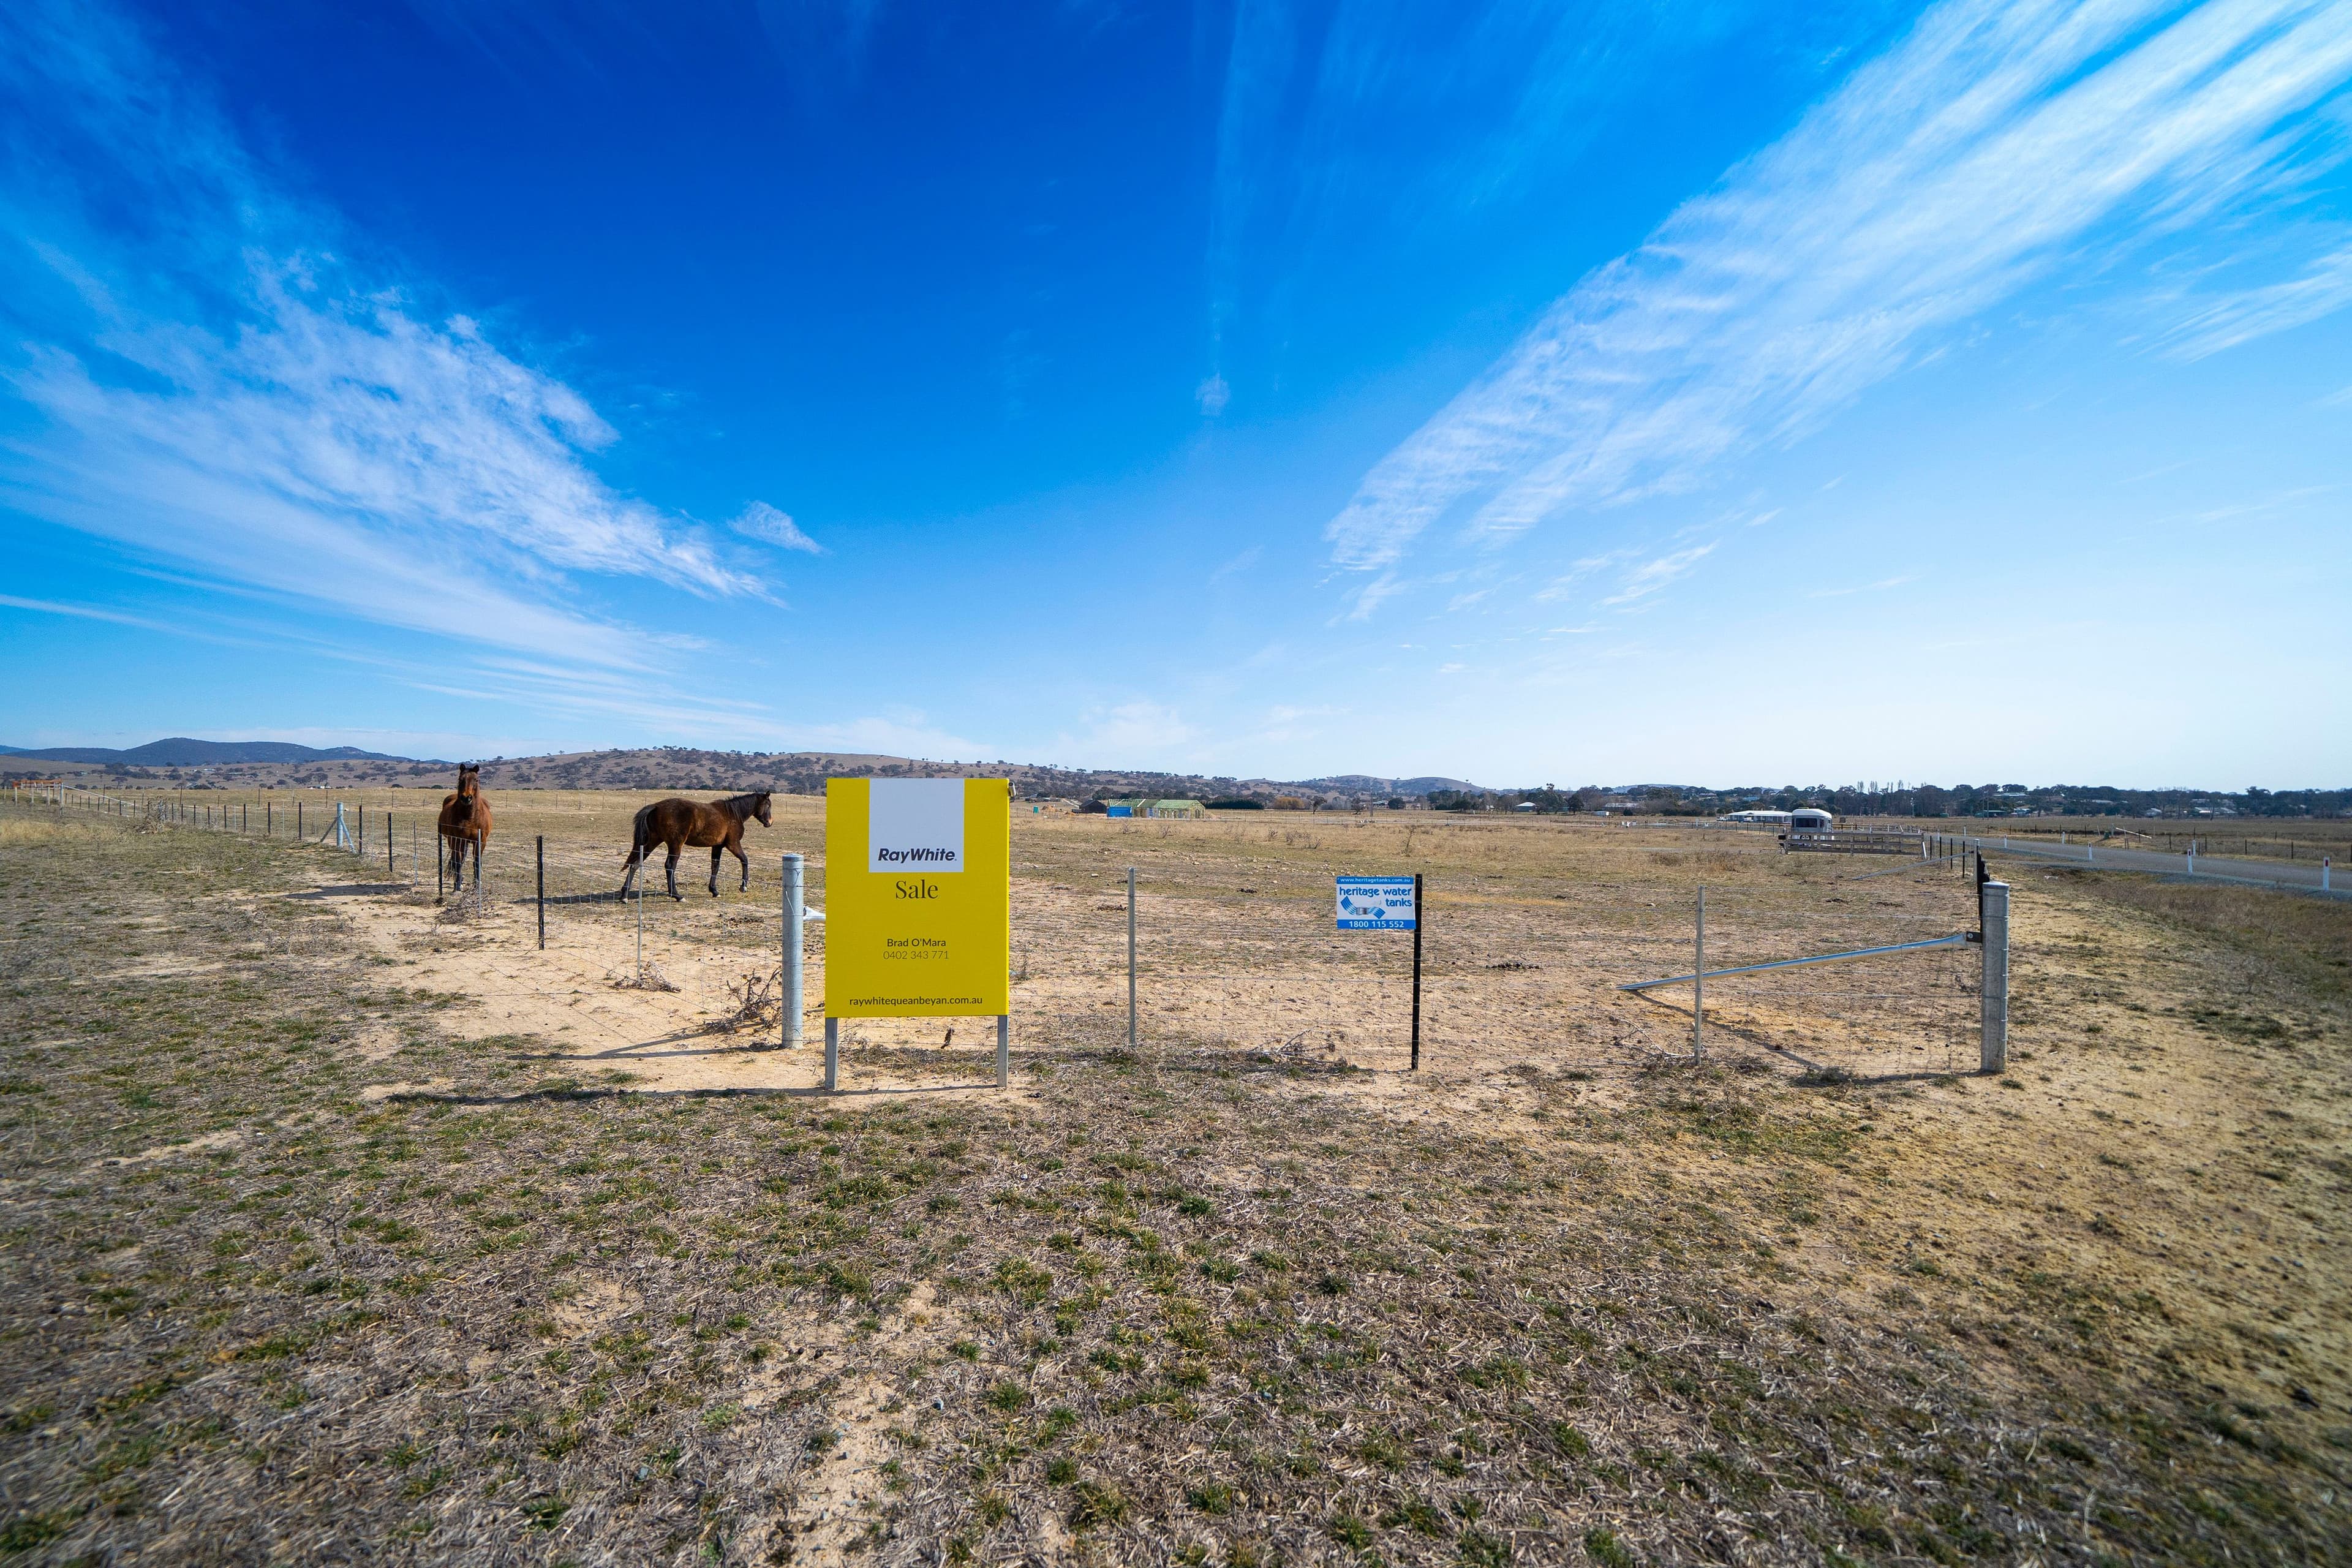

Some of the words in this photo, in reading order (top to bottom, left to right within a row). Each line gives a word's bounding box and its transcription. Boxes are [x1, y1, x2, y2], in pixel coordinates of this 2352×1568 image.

[895, 879, 938, 899] Sale
[1339, 886, 1379, 897] heritage
[1385, 898, 1412, 907] tanks
[883, 951, 908, 959] 0402
[910, 951, 929, 959] 343
[931, 950, 949, 959] 771
[849, 996, 982, 1006] raywhitequeanbeyan.com.au
